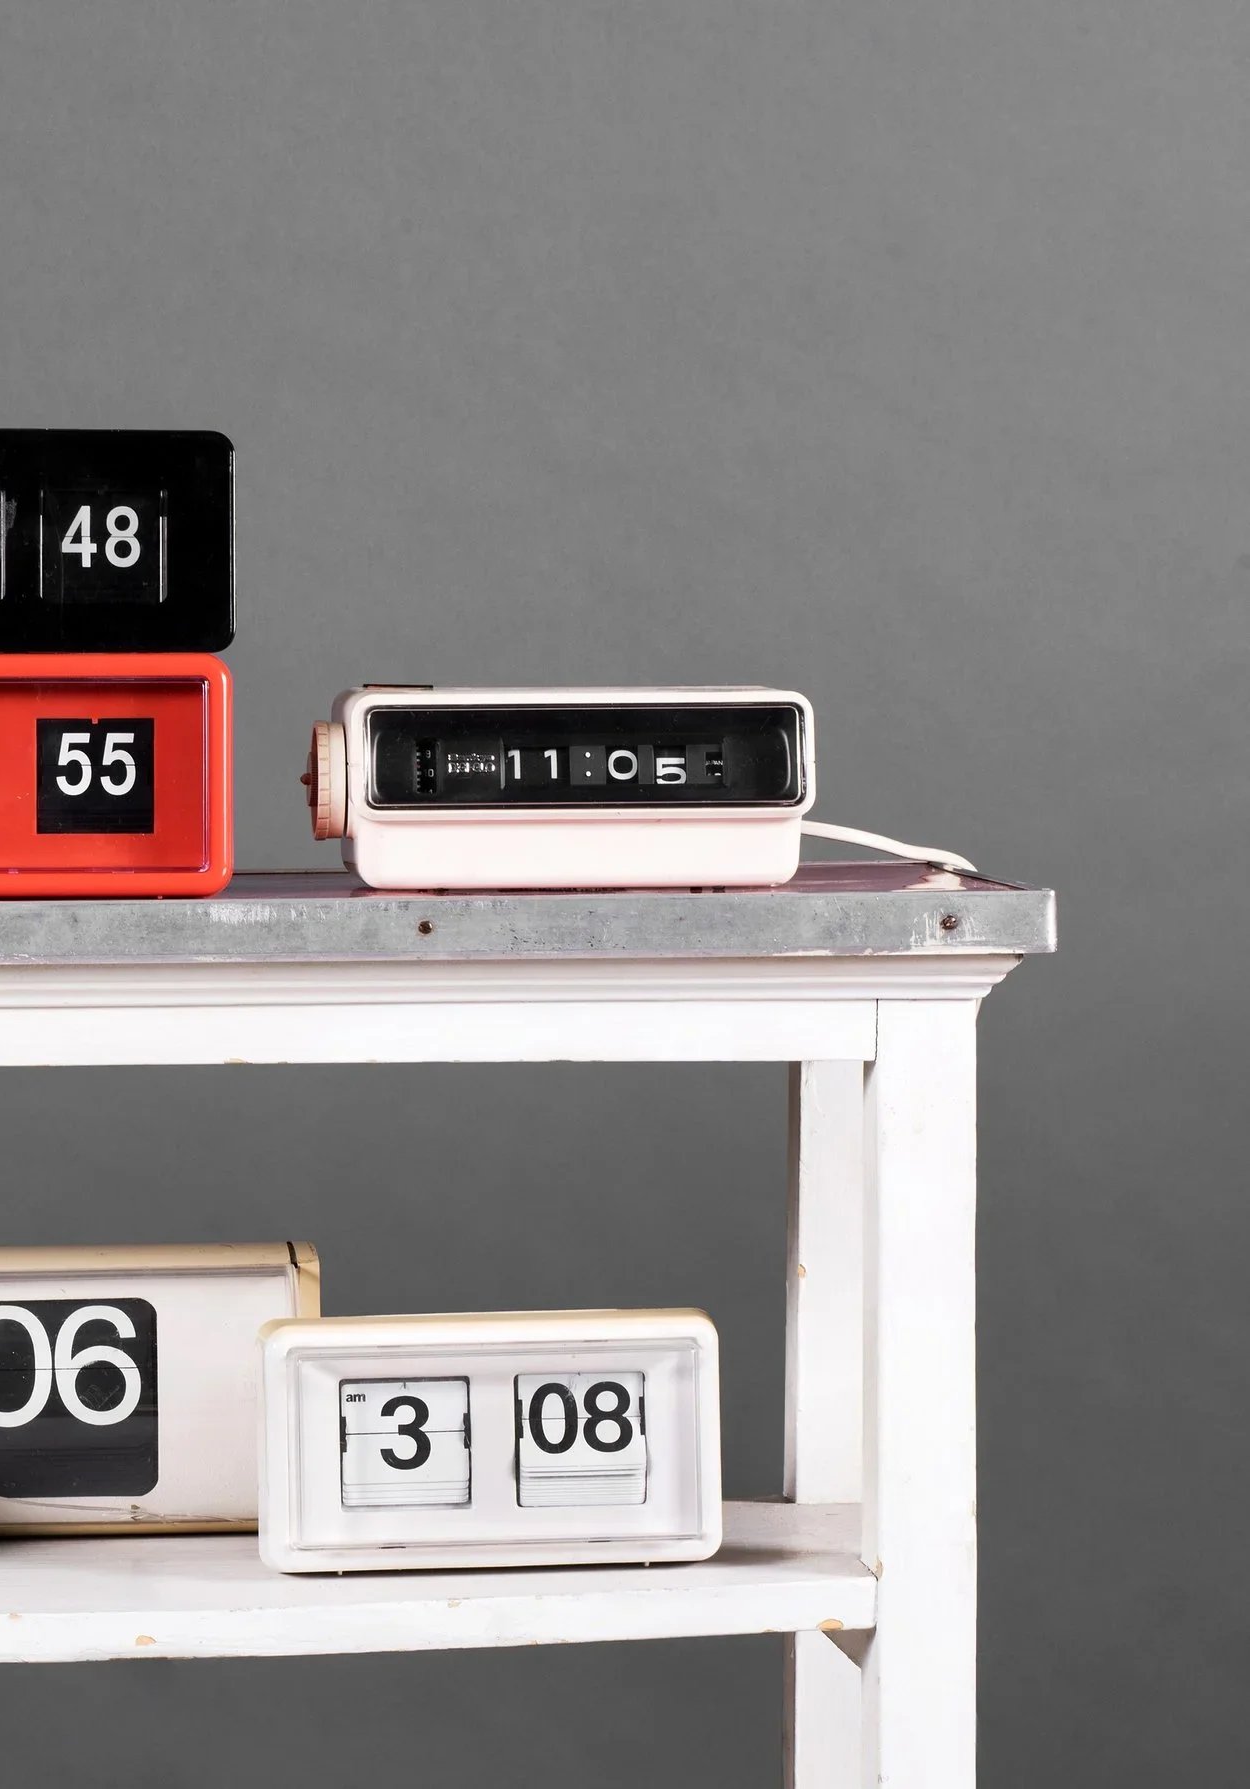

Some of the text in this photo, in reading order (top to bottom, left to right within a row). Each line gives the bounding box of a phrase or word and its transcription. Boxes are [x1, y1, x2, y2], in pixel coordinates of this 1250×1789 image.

[61, 505, 141, 568] 48
[55, 732, 137, 796] 55
[345, 1393, 366, 1403] am
[380, 1381, 633, 1470] 3 08
